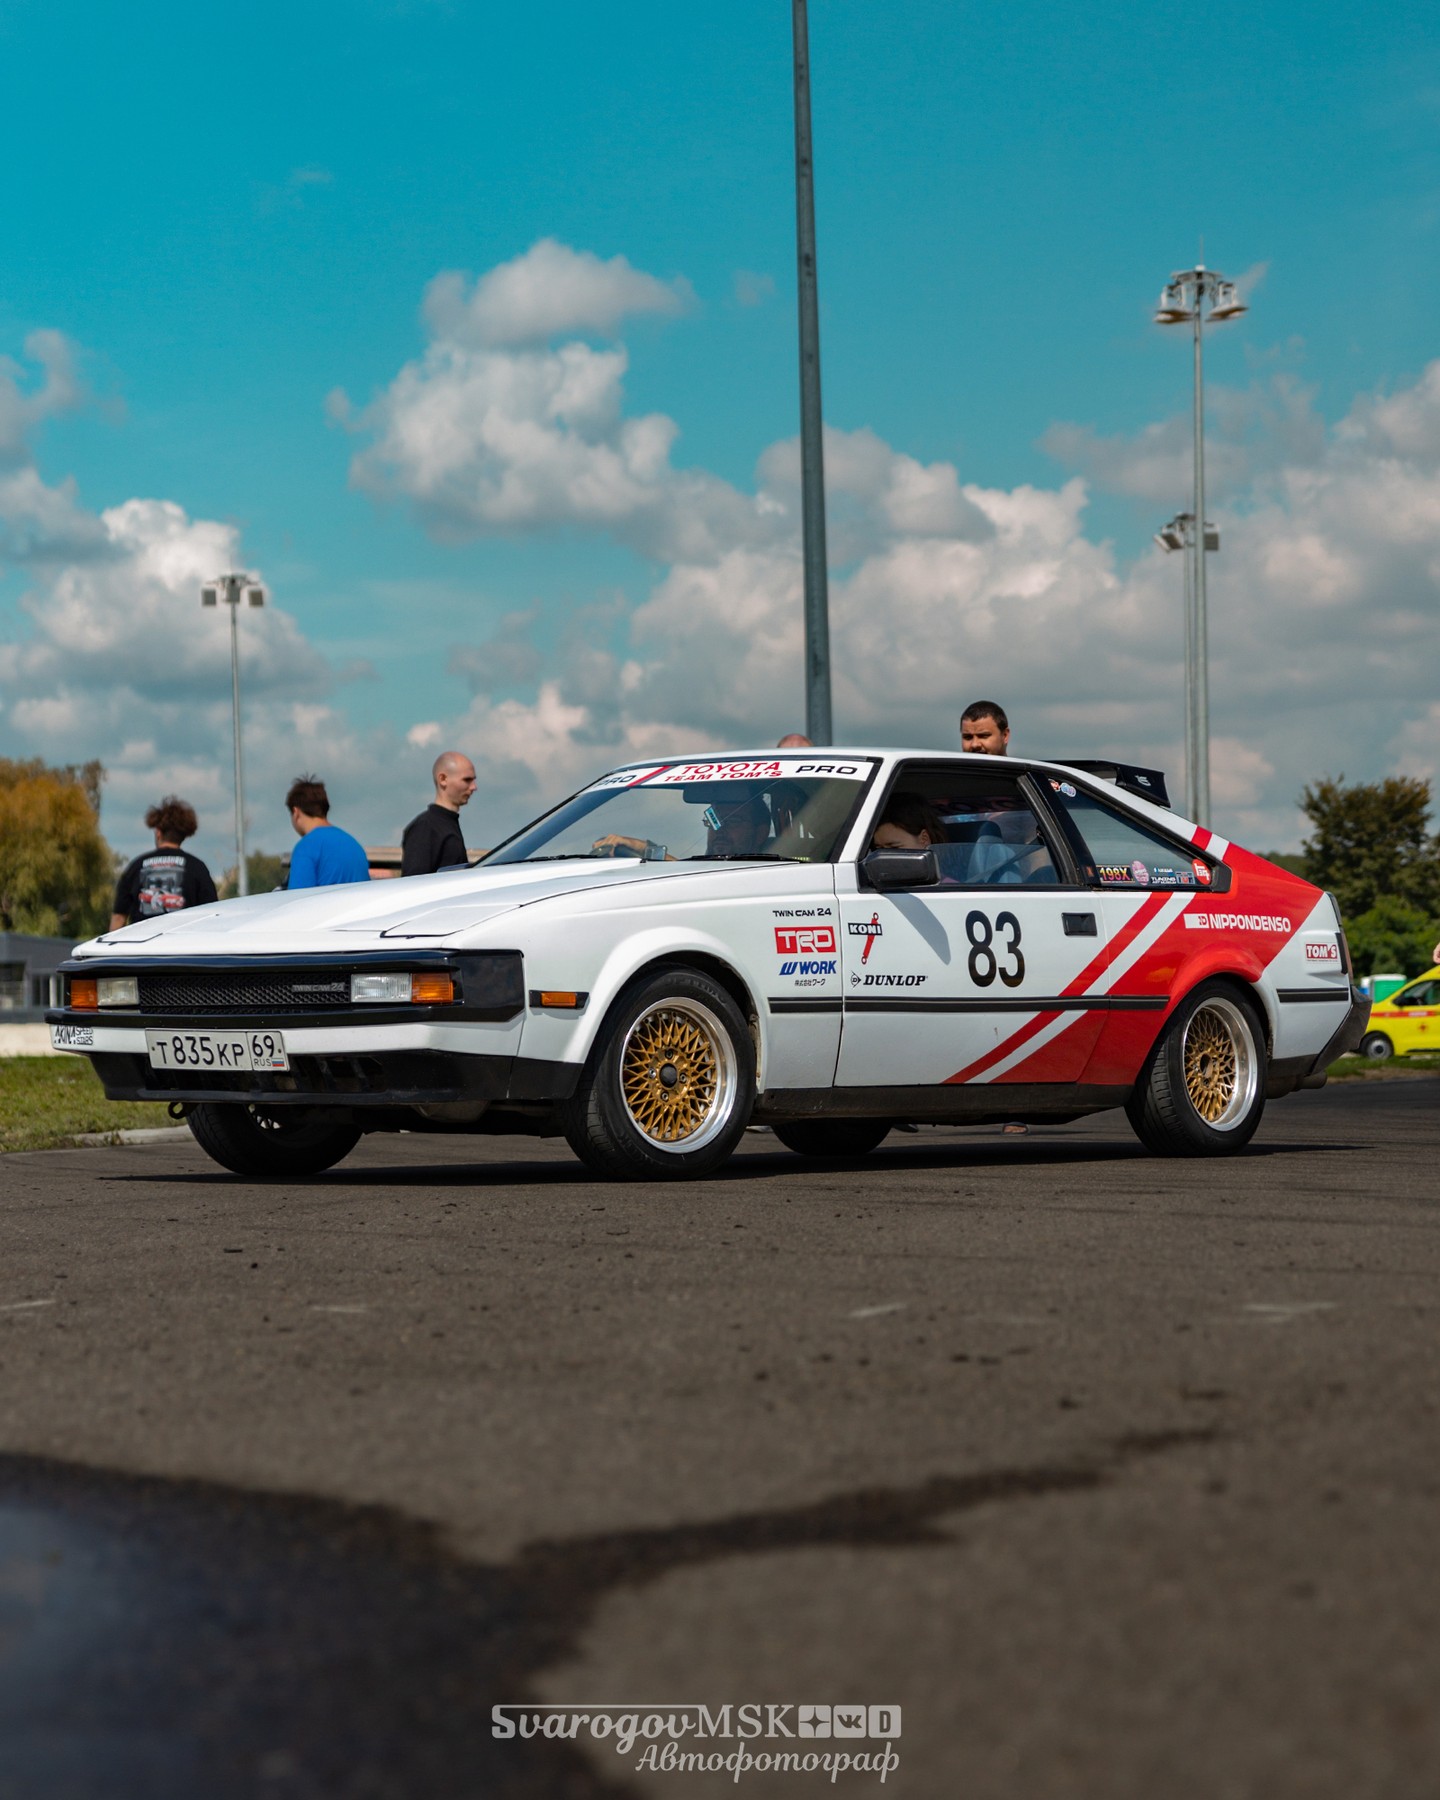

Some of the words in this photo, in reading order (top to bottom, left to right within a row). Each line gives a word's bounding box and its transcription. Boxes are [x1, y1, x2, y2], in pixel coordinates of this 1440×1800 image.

[682, 761, 780, 774] TOYOTA
[795, 764, 858, 775] PRO
[663, 772, 718, 782] TEAM
[720, 770, 783, 778] TOM'S
[1099, 867, 1131, 881] 198X
[795, 909, 816, 917] CAM
[817, 908, 832, 916] 24
[849, 924, 882, 935] KONI
[1209, 913, 1292, 933] NIPPONDENSO
[777, 928, 833, 953] TRD
[965, 910, 1025, 988] 83
[1306, 945, 1337, 958] TOM'S
[800, 960, 837, 975] WORK
[863, 975, 926, 986] DUNLOP
[252, 1034, 275, 1058] 69
[254, 1058, 272, 1067] RUS
